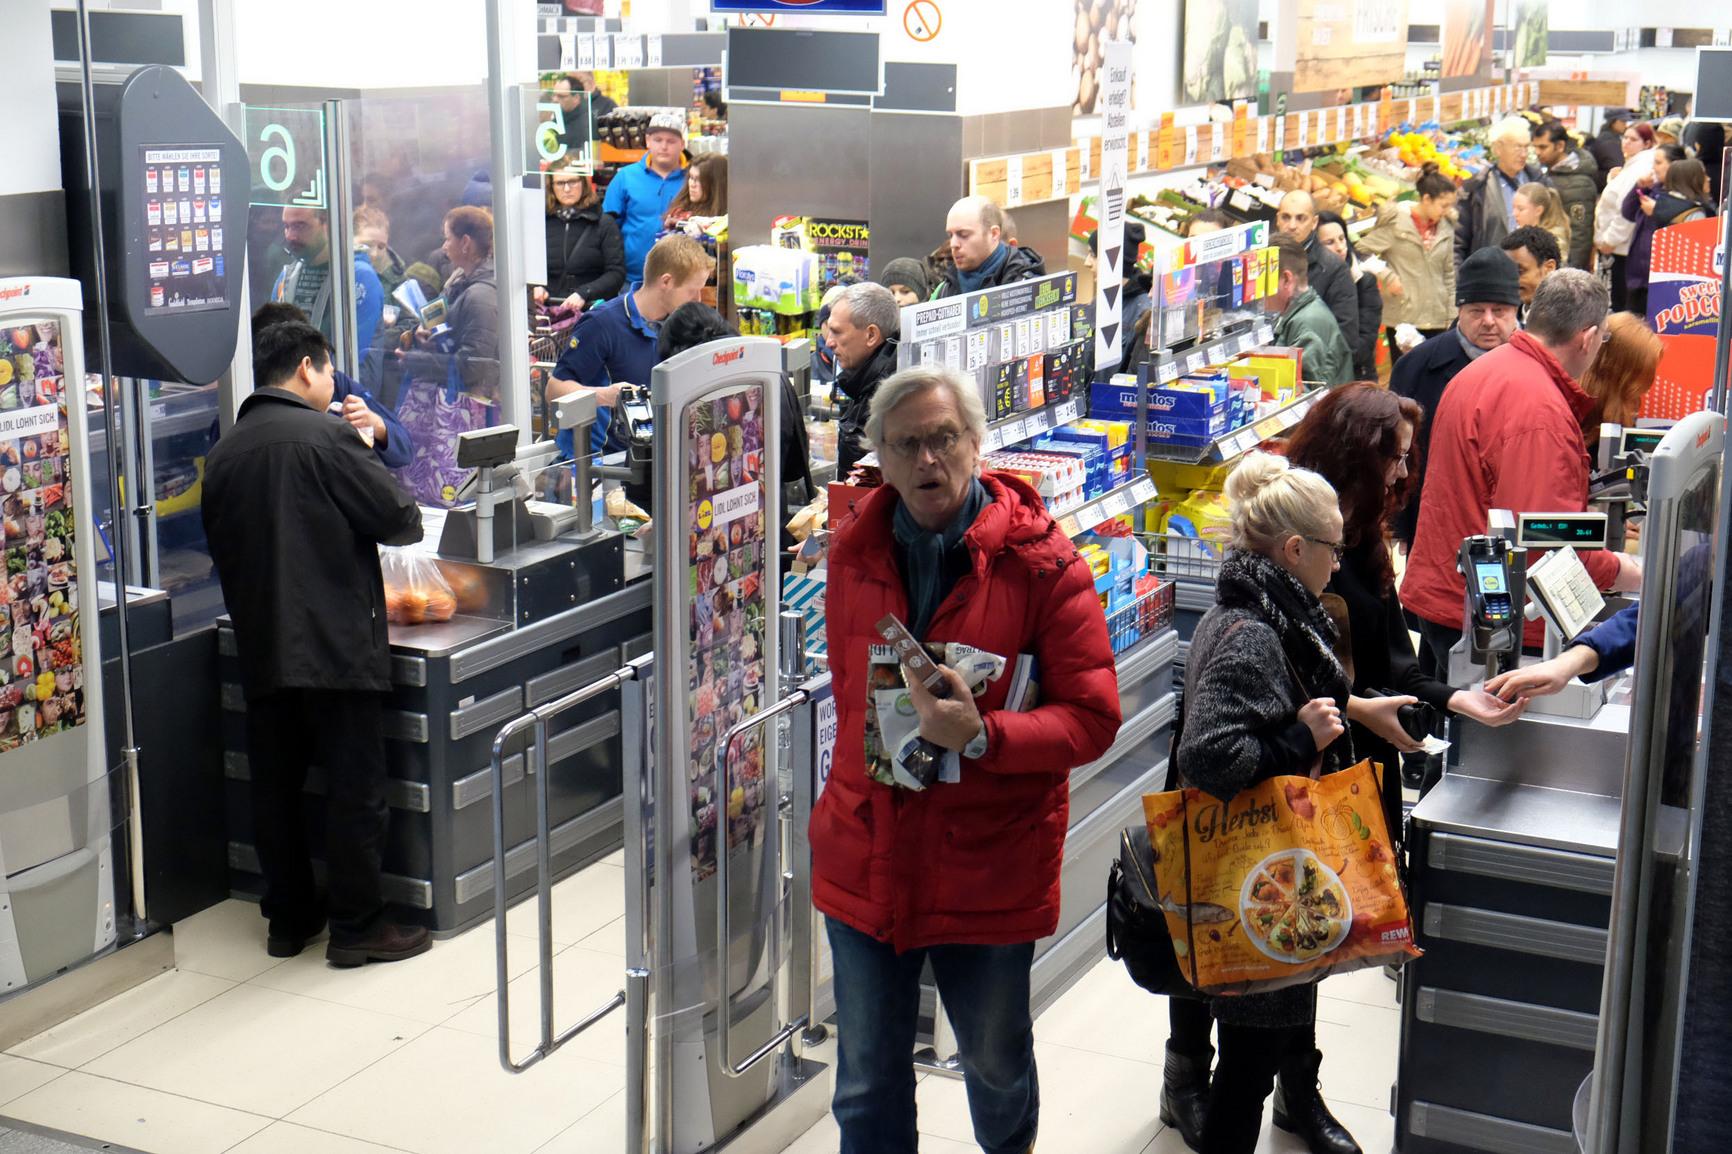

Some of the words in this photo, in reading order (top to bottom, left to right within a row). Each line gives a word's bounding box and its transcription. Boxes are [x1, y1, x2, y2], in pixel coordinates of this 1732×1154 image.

[917, 304, 961, 325] PREPAID-GUTHABEN
[1120, 391, 1177, 408] mtos
[16, 415, 38, 429] LOHNT
[714, 503, 726, 516] LIDL
[727, 495, 743, 512] LOHNT
[1194, 796, 1280, 843] Herbst
[1381, 926, 1409, 941] REW
